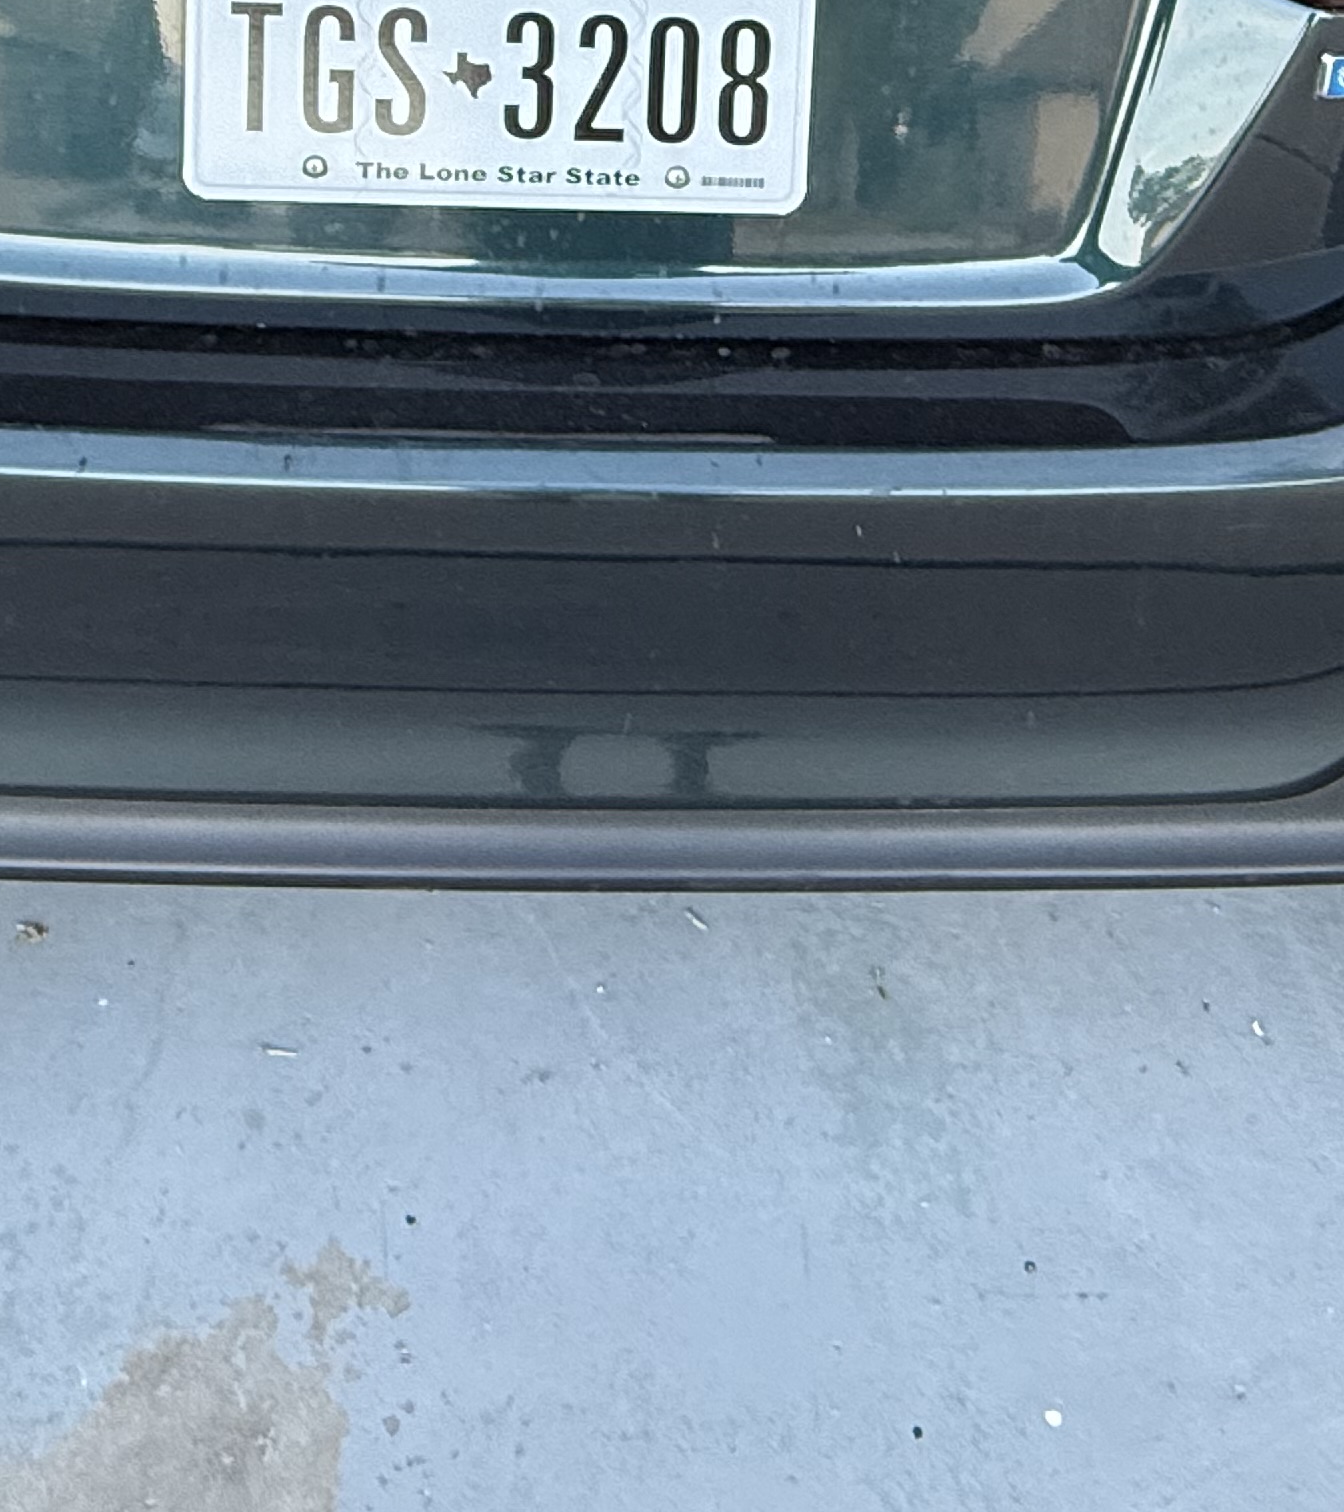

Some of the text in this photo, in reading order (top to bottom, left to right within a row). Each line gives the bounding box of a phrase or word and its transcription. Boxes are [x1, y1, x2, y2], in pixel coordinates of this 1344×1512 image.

[230, 0, 771, 146] TGS 3208
[355, 160, 641, 188] The Lone Star State
